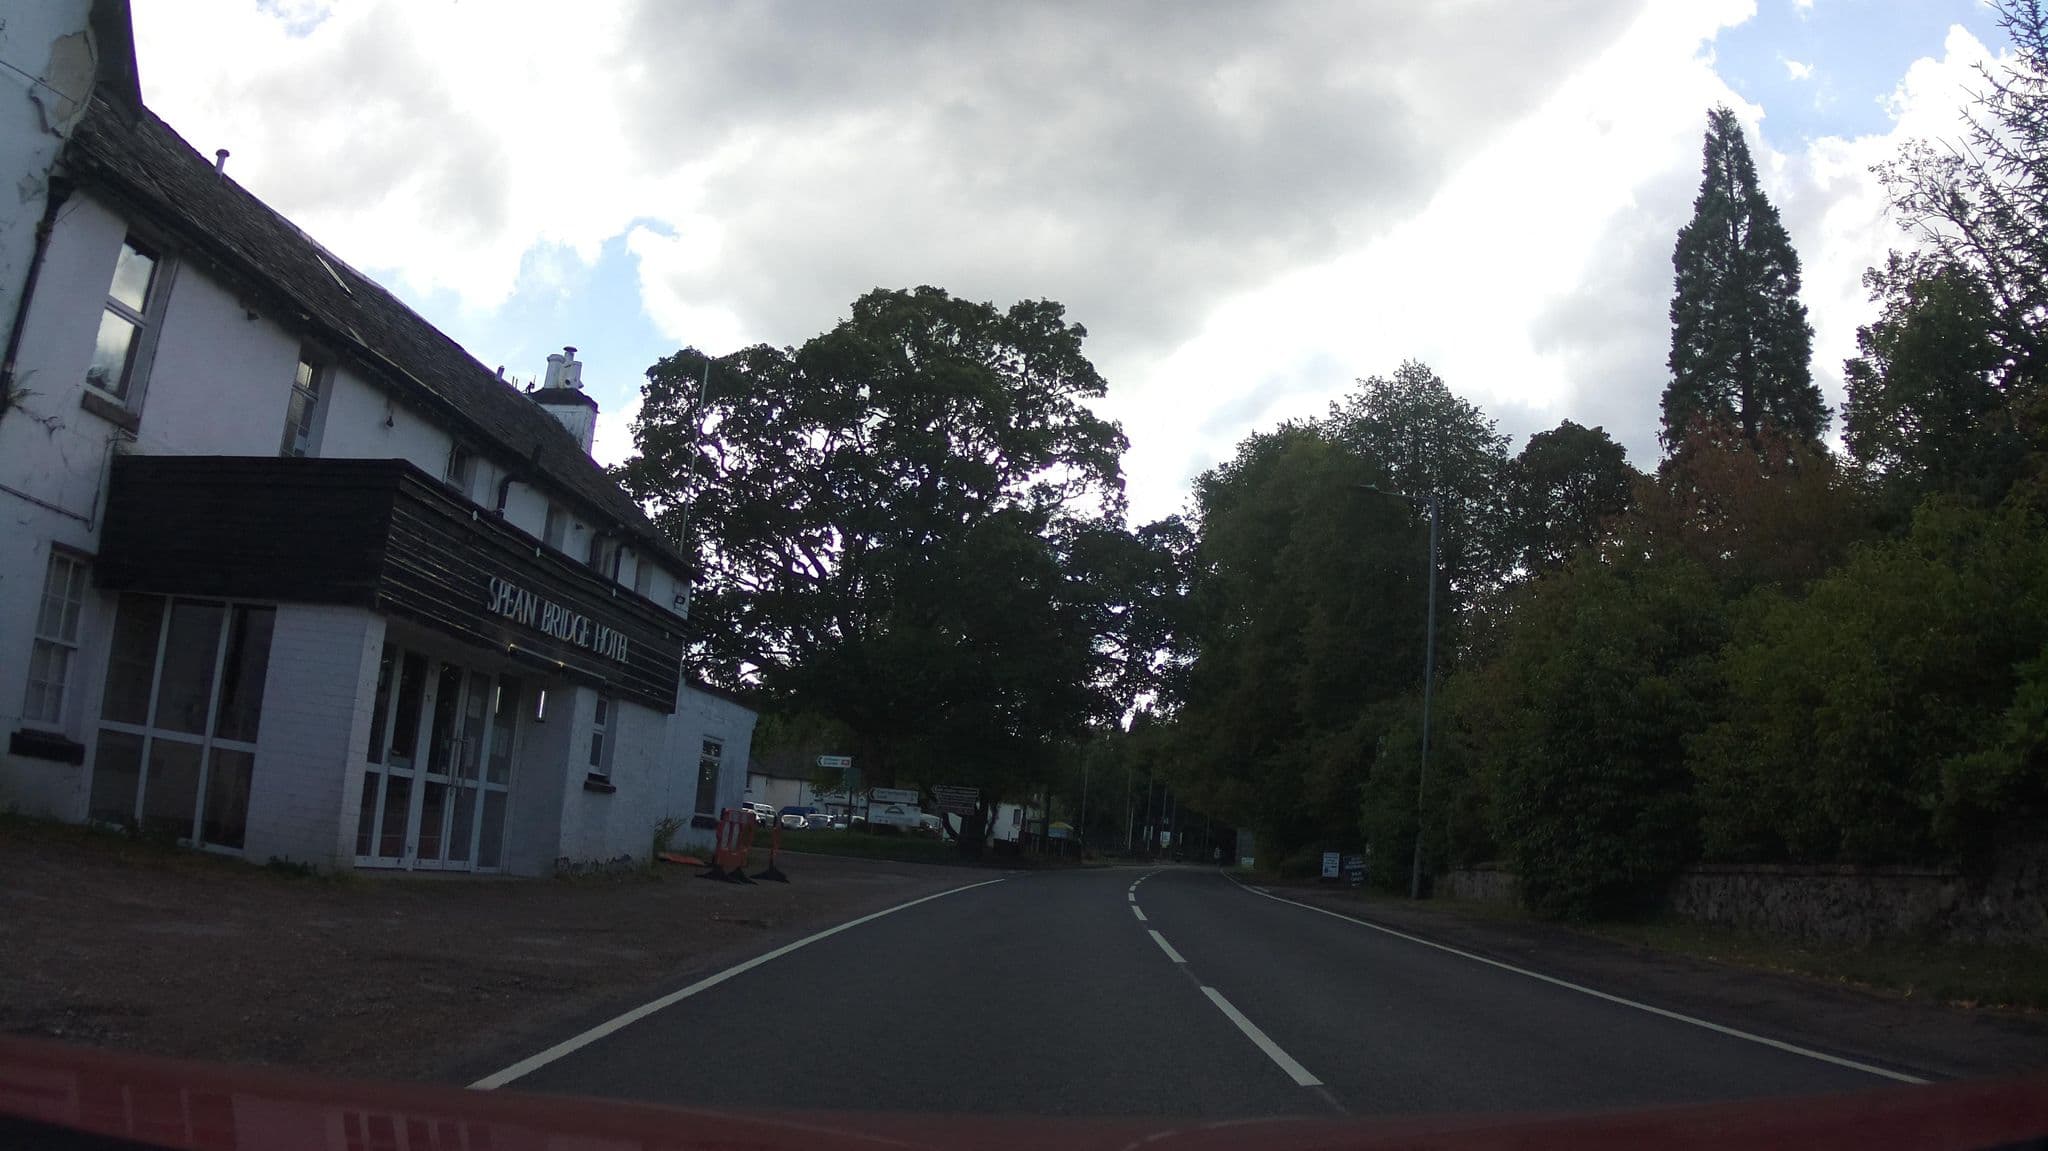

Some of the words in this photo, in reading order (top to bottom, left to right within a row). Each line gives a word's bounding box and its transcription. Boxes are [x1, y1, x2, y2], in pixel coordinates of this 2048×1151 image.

[487, 577, 537, 628] SPEAN
[540, 600, 591, 648] BRIDGE
[593, 623, 629, 664] HOTEL
